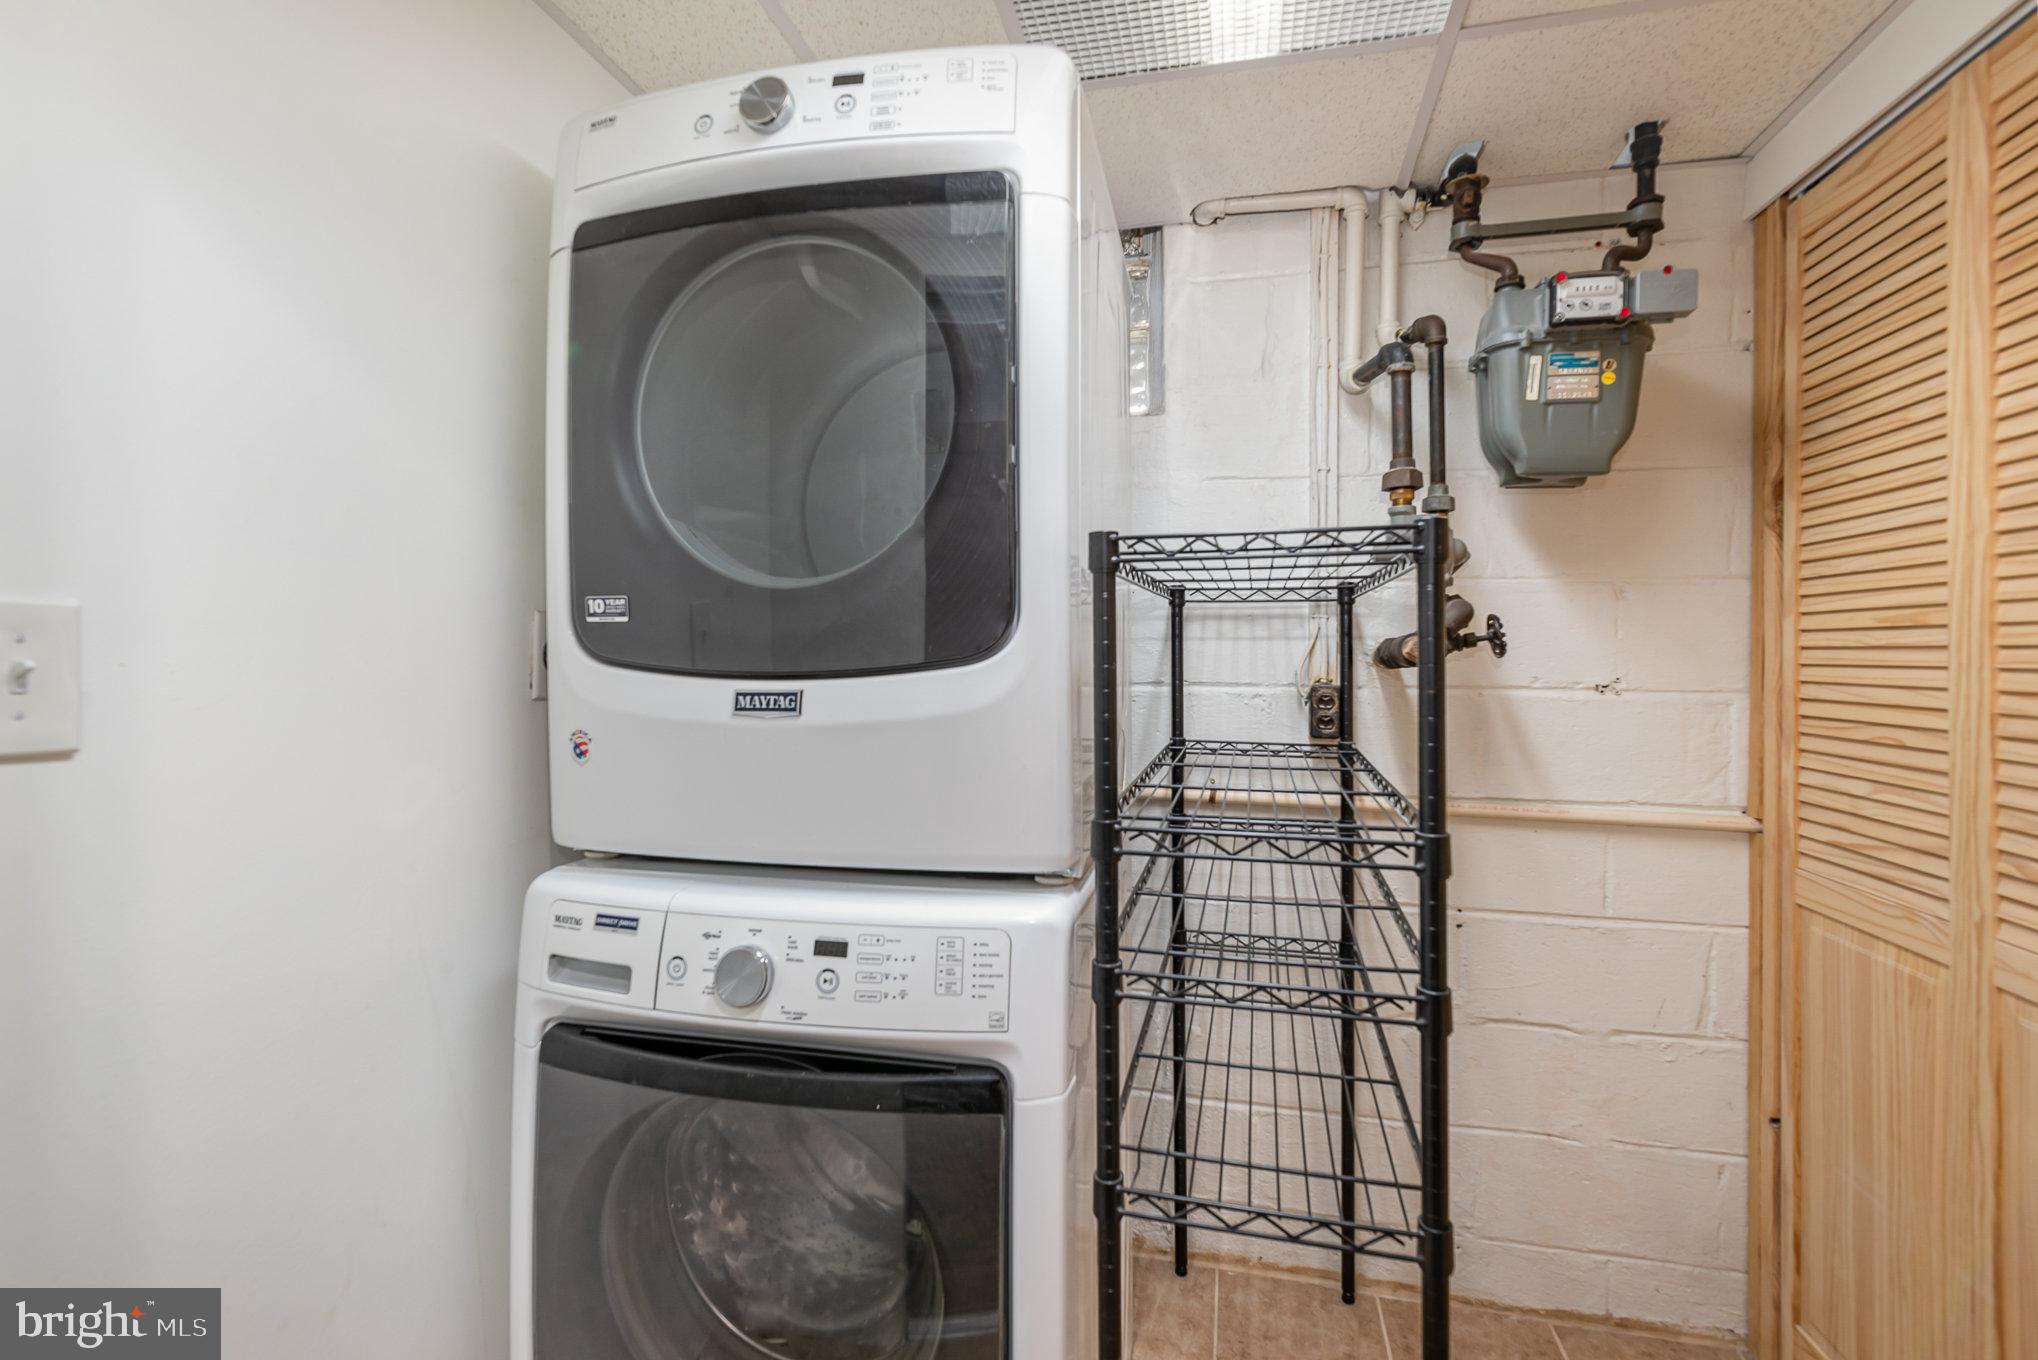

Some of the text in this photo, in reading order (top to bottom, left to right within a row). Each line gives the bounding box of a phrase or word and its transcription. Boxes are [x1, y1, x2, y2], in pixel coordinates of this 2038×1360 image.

[587, 599, 605, 613] 10
[605, 598, 626, 606] YEAR
[736, 695, 796, 709] MAYTAG
